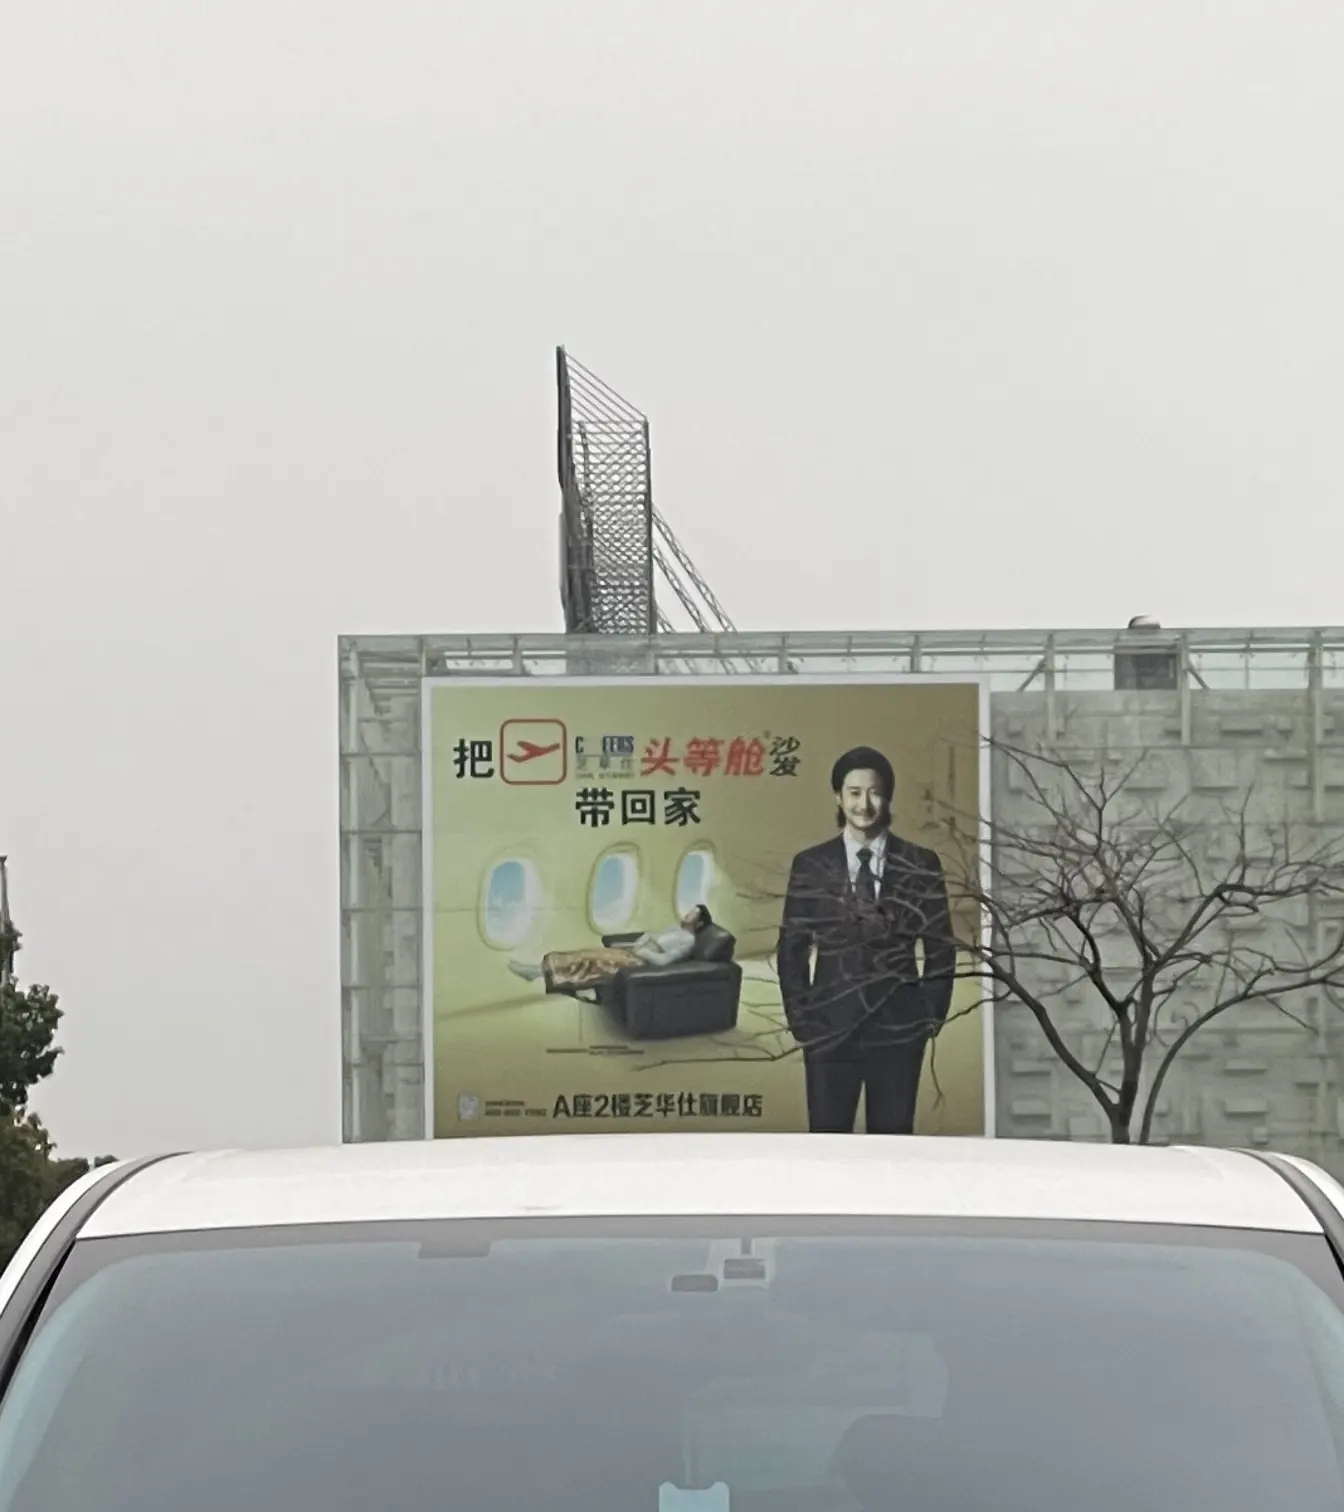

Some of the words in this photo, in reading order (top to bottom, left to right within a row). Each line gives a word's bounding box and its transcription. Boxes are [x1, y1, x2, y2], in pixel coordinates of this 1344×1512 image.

[453, 738, 494, 779] 把
[640, 735, 766, 777] 头等舱
[769, 735, 802, 777] 沙发
[575, 786, 701, 828] 带回家
